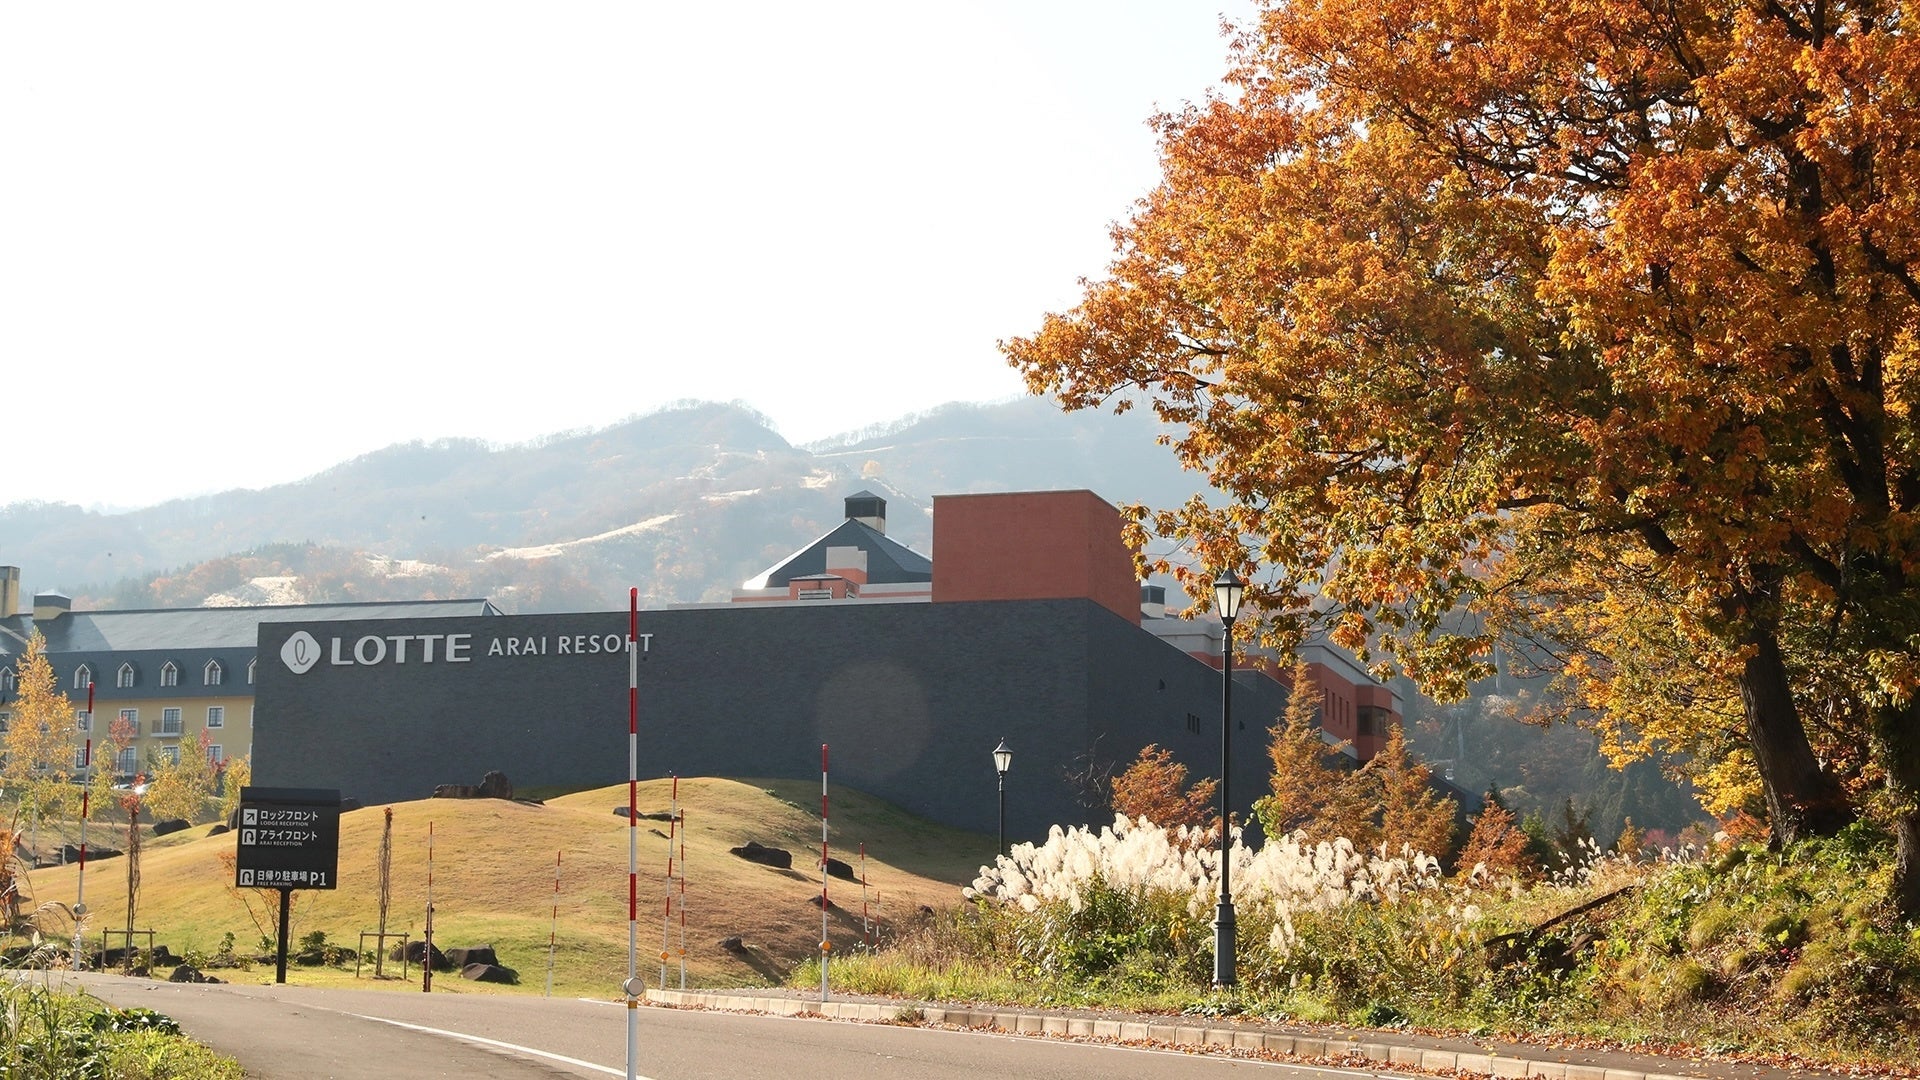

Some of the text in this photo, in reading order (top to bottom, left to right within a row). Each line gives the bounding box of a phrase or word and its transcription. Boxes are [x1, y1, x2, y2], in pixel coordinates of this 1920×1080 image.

[331, 634, 472, 666] LOTTE
[488, 637, 547, 656] ARAI
[260, 810, 318, 821] ロッジフロント
[259, 830, 317, 841] アライフロント
[257, 870, 326, 886] 日帰り駐車場 P1
